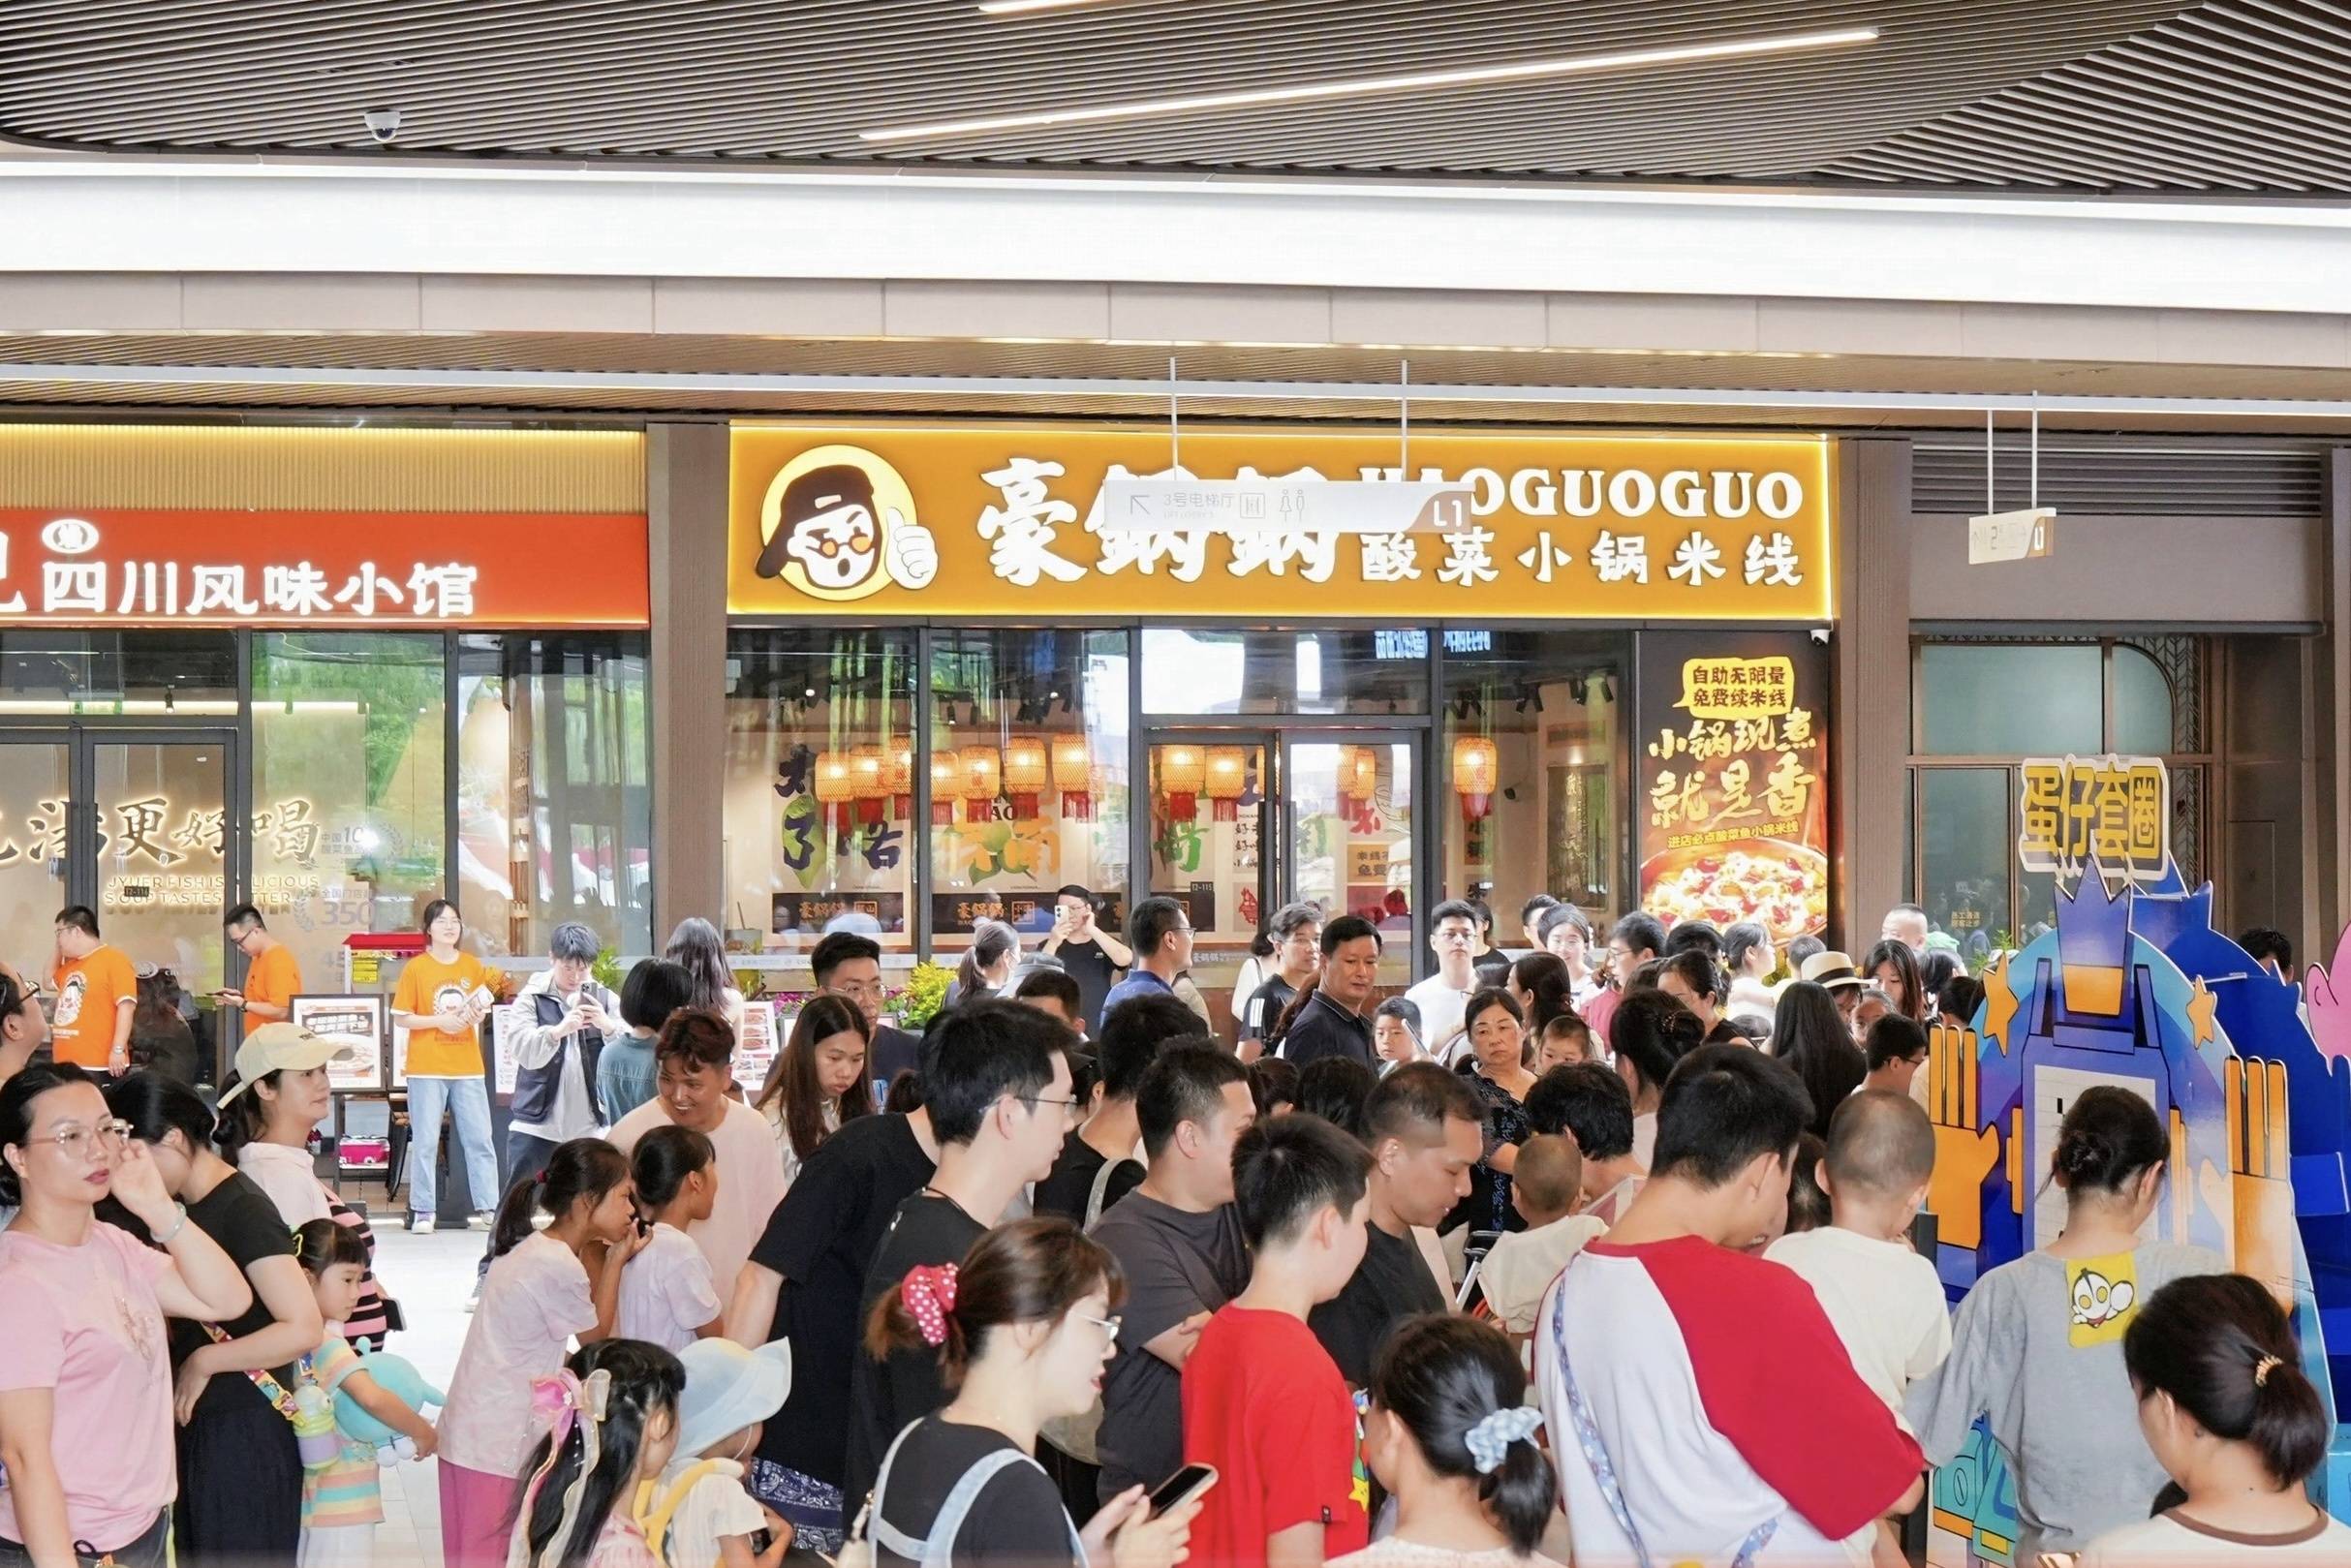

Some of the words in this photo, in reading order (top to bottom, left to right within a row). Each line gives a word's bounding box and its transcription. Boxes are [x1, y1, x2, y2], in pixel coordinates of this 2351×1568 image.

[1358, 467, 1804, 520] OGUOGUO
[1433, 499, 1463, 528] L1
[1358, 526, 1805, 587] 酸菜小锅米线
[42, 560, 478, 618] 四川风味小馆
[1692, 665, 1786, 686] 自助无限量
[1693, 688, 1787, 708] 免费续米线
[1648, 706, 1817, 761] 小锅现煮
[1649, 751, 1817, 832] 就是香
[2022, 760, 2161, 862] 蛋仔套圈
[161, 891, 223, 905] TASTES
[251, 891, 292, 905] TTER
[252, 876, 319, 888] LICIOUS
